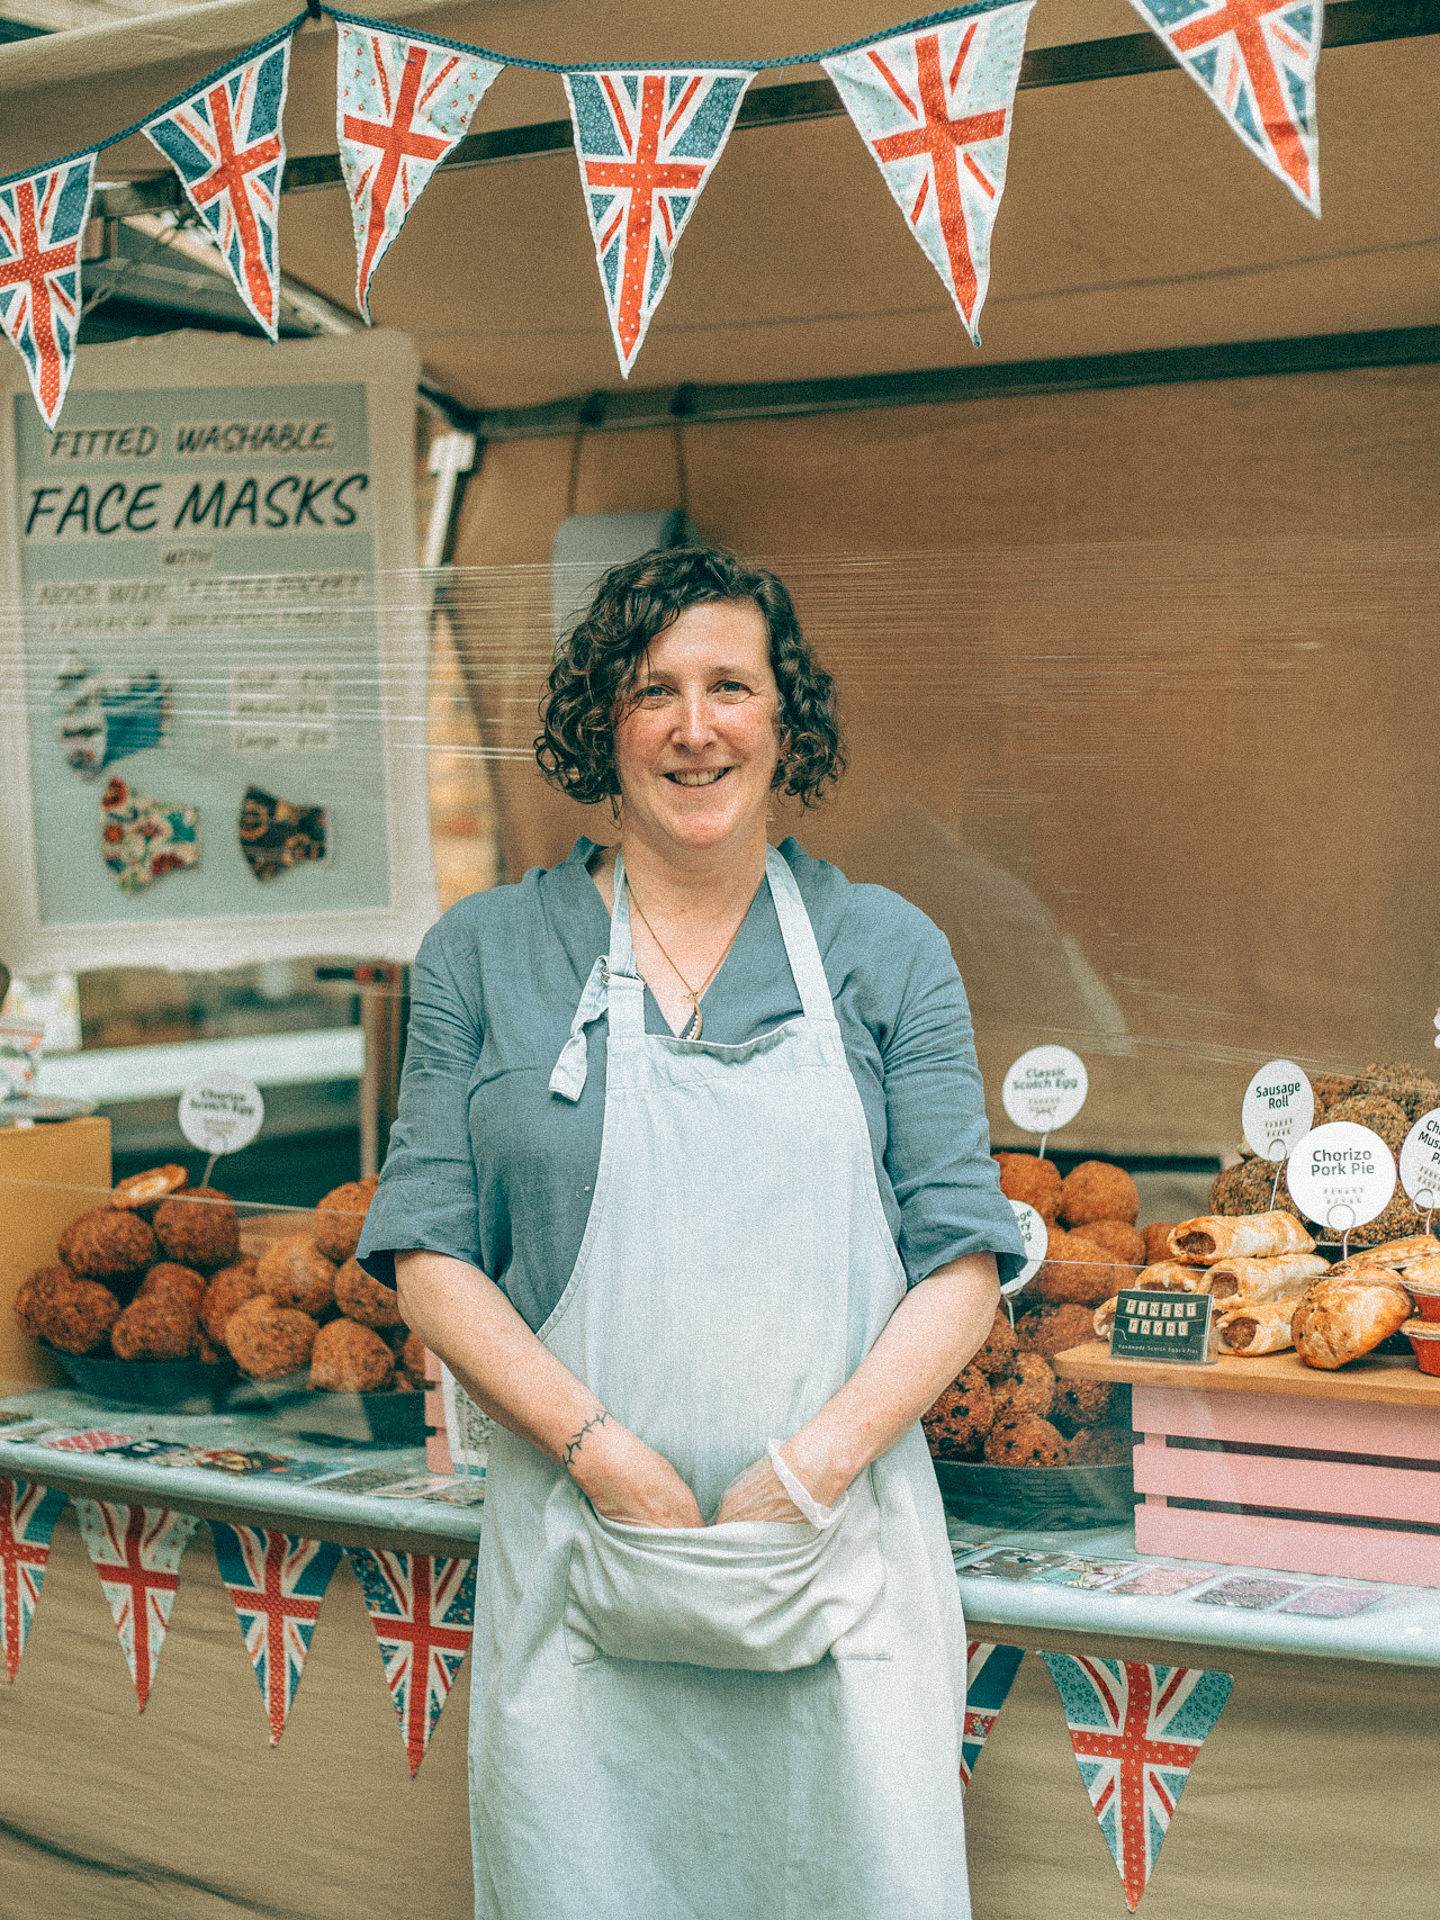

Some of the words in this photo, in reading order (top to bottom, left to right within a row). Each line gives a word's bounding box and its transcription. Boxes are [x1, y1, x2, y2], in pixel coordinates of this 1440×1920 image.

[50, 427, 159, 457] FITTED
[26, 482, 163, 535] FACE
[173, 473, 370, 530] MASKS
[1026, 1067, 1066, 1079] Classic
[1013, 1079, 1052, 1090] Scotch
[1055, 1078, 1079, 1090] Egg
[1256, 1082, 1301, 1099] Sausage
[1268, 1095, 1289, 1110] Roll
[1426, 1120, 1440, 1136] Ch
[1418, 1131, 1440, 1150] Mus
[1313, 1148, 1372, 1162] Chorizo
[1311, 1163, 1347, 1176] Pork
[1351, 1161, 1375, 1175] Pie
[1128, 1302, 1195, 1315] FINEST
[1131, 1322, 1186, 1333] FAYRE
